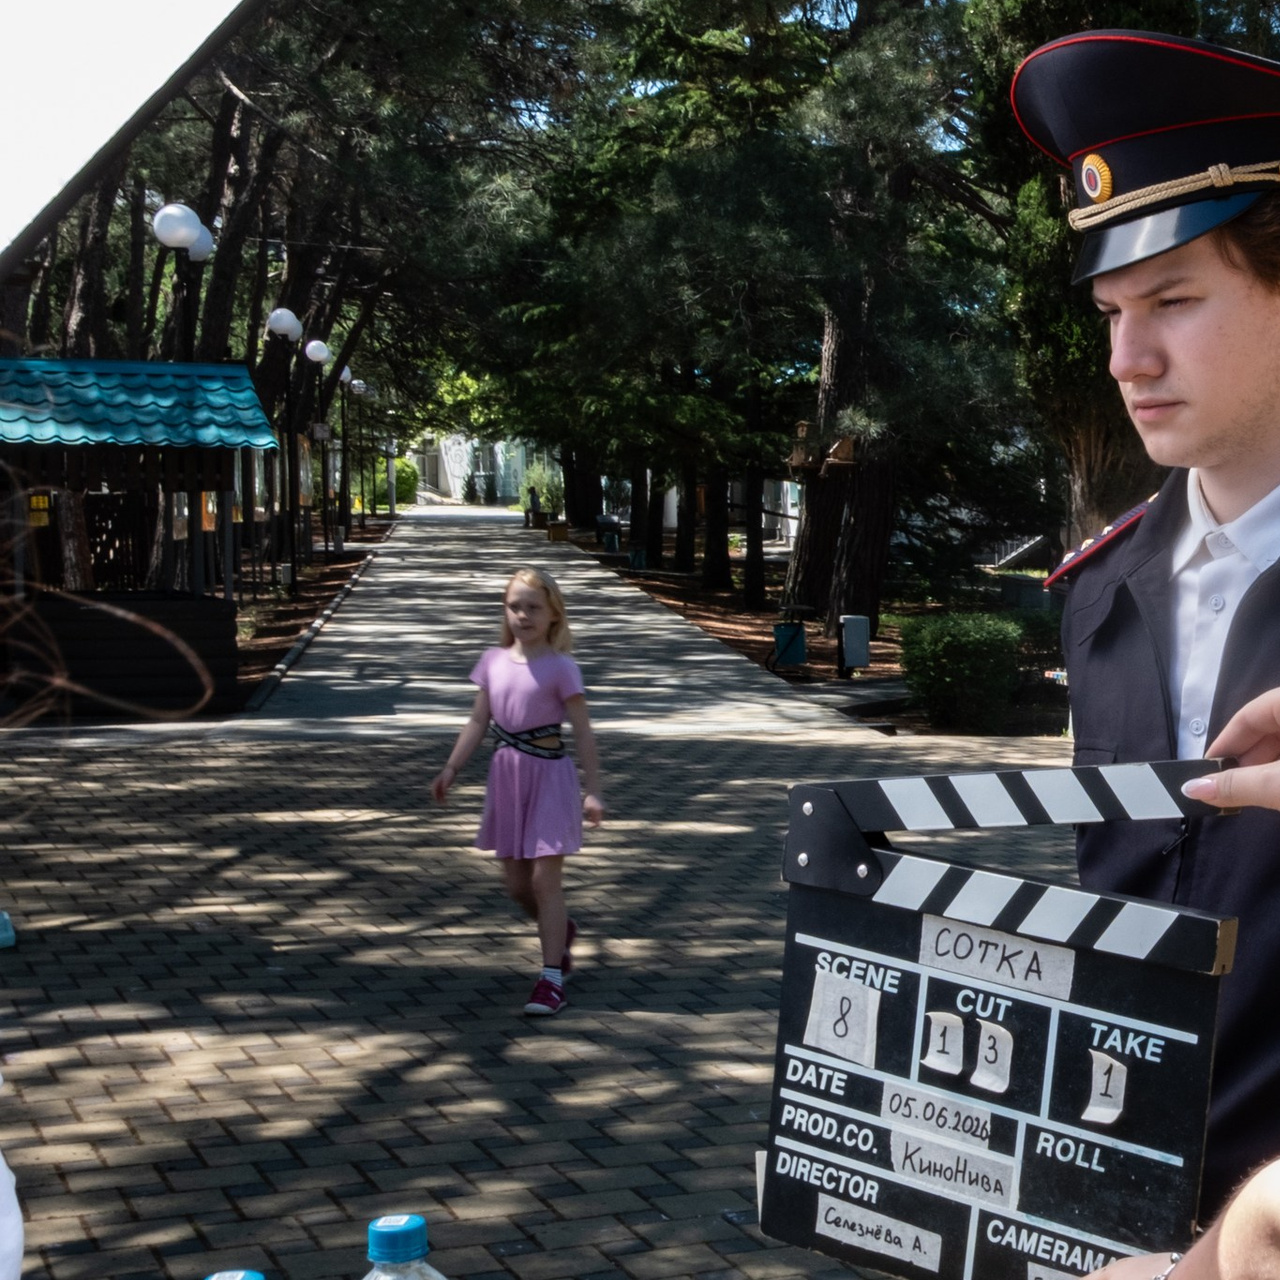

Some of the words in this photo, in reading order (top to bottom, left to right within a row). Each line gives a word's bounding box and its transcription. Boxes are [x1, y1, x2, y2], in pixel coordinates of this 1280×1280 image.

[815, 951, 901, 994] SCENE
[934, 926, 1042, 981] СОТКА
[832, 996, 852, 1038] 8
[956, 988, 1012, 1022] CUT
[1090, 1022, 1166, 1063] TAKE
[786, 1058, 848, 1096] DATE
[1099, 1062, 1113, 1099] 1
[780, 1104, 878, 1154] PROD.CO.
[889, 1092, 991, 1142] 05.06.2026
[1036, 1132, 1105, 1173] ROLL
[775, 1151, 879, 1204] DIRECTOR
[986, 1219, 1117, 1274] CAMERAM
